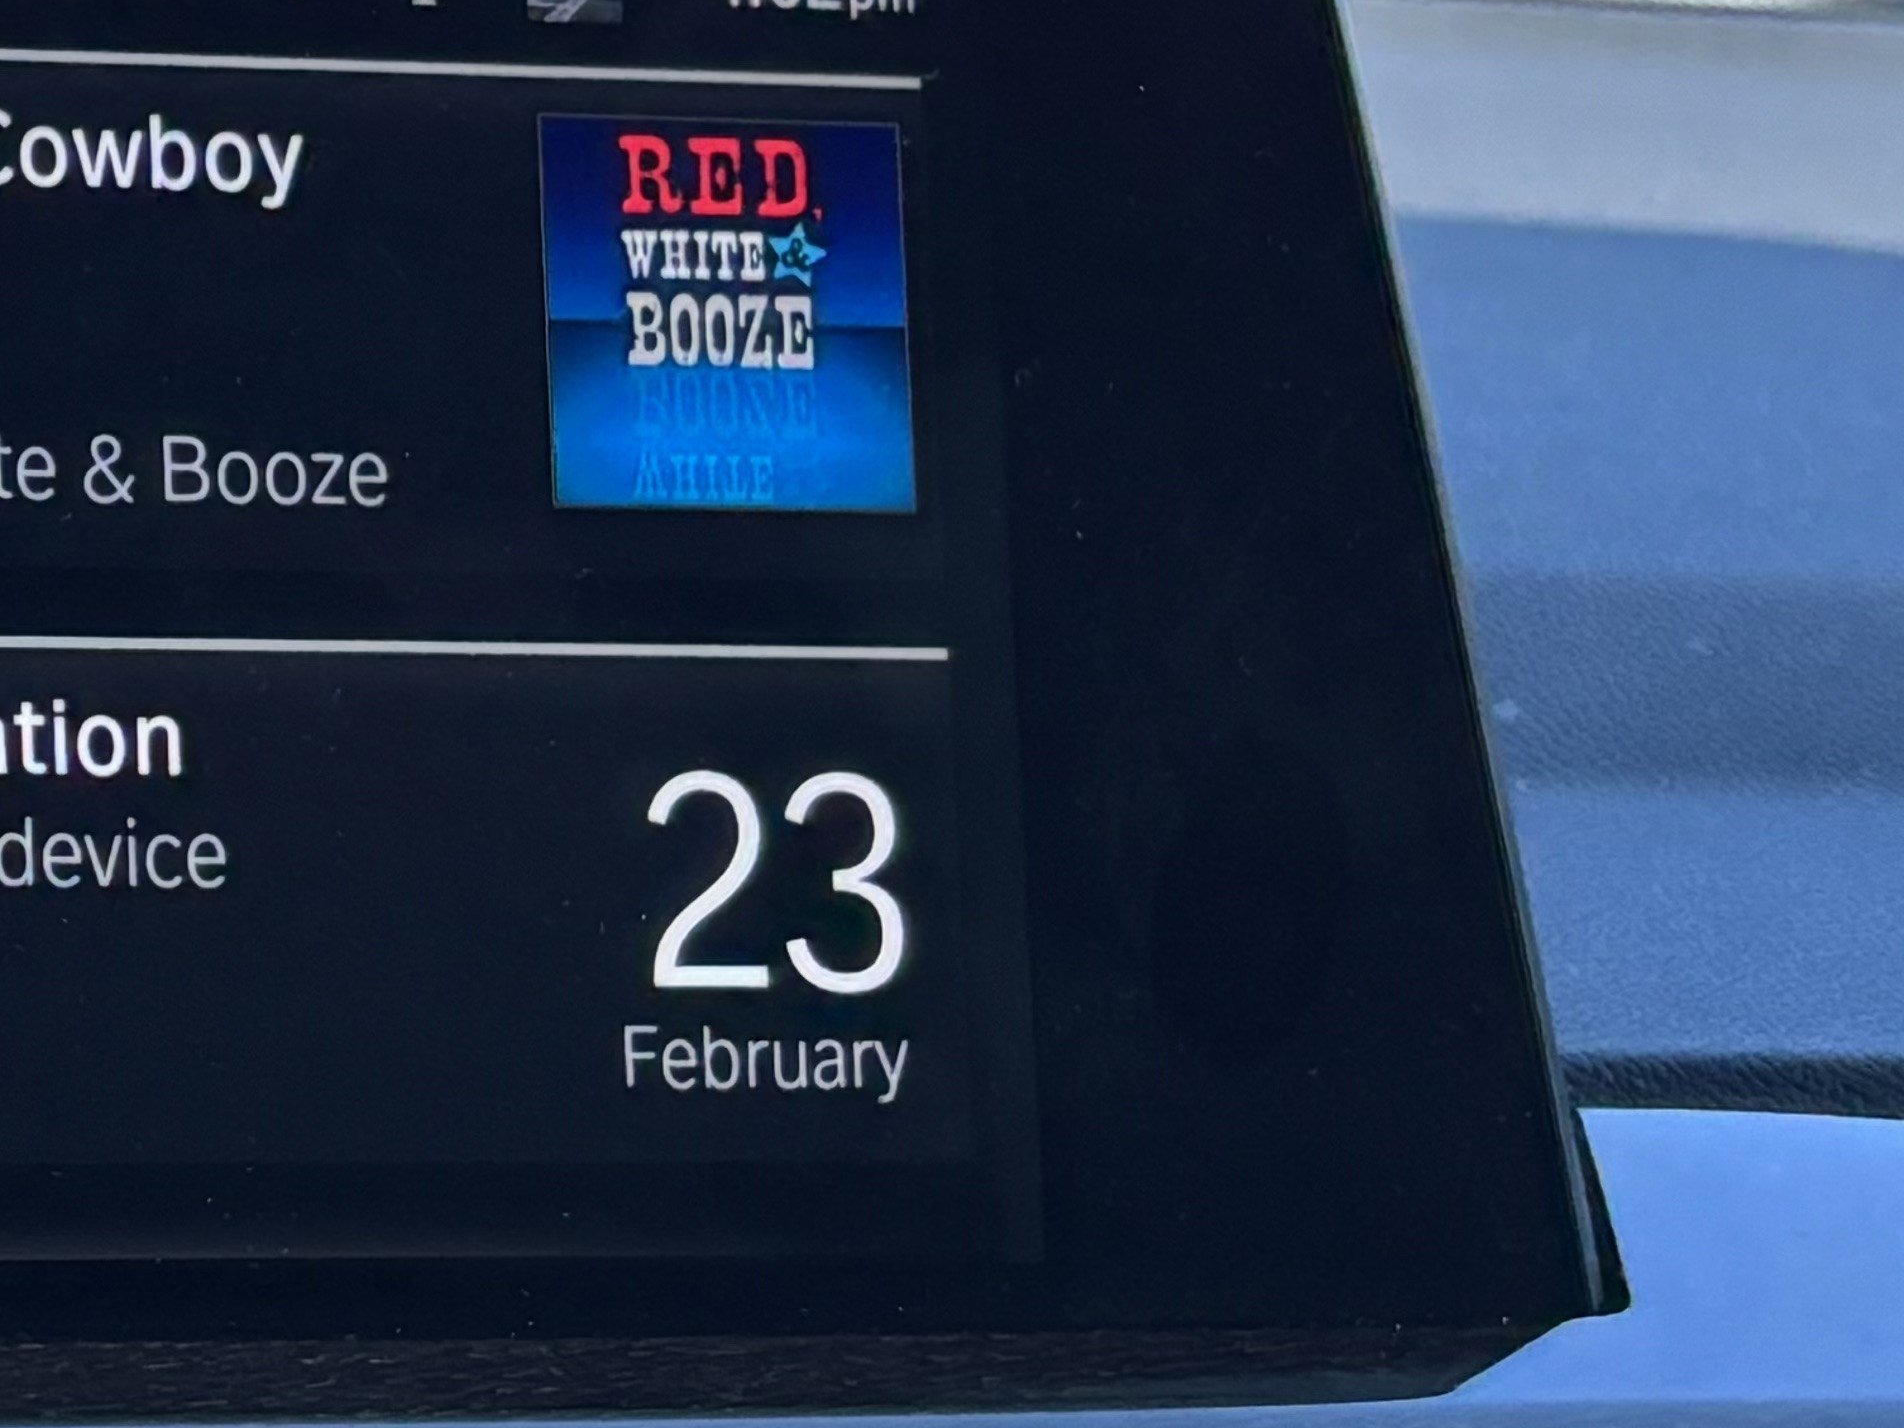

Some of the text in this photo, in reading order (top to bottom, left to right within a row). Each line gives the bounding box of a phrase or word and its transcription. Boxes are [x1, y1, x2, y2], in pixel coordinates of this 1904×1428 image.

[621, 229, 766, 280] WHITE
[626, 291, 814, 370] BOOZE
[83, 434, 135, 504] &
[162, 435, 388, 507] Booze
[647, 770, 905, 994] 23
[624, 1025, 909, 1103] February
